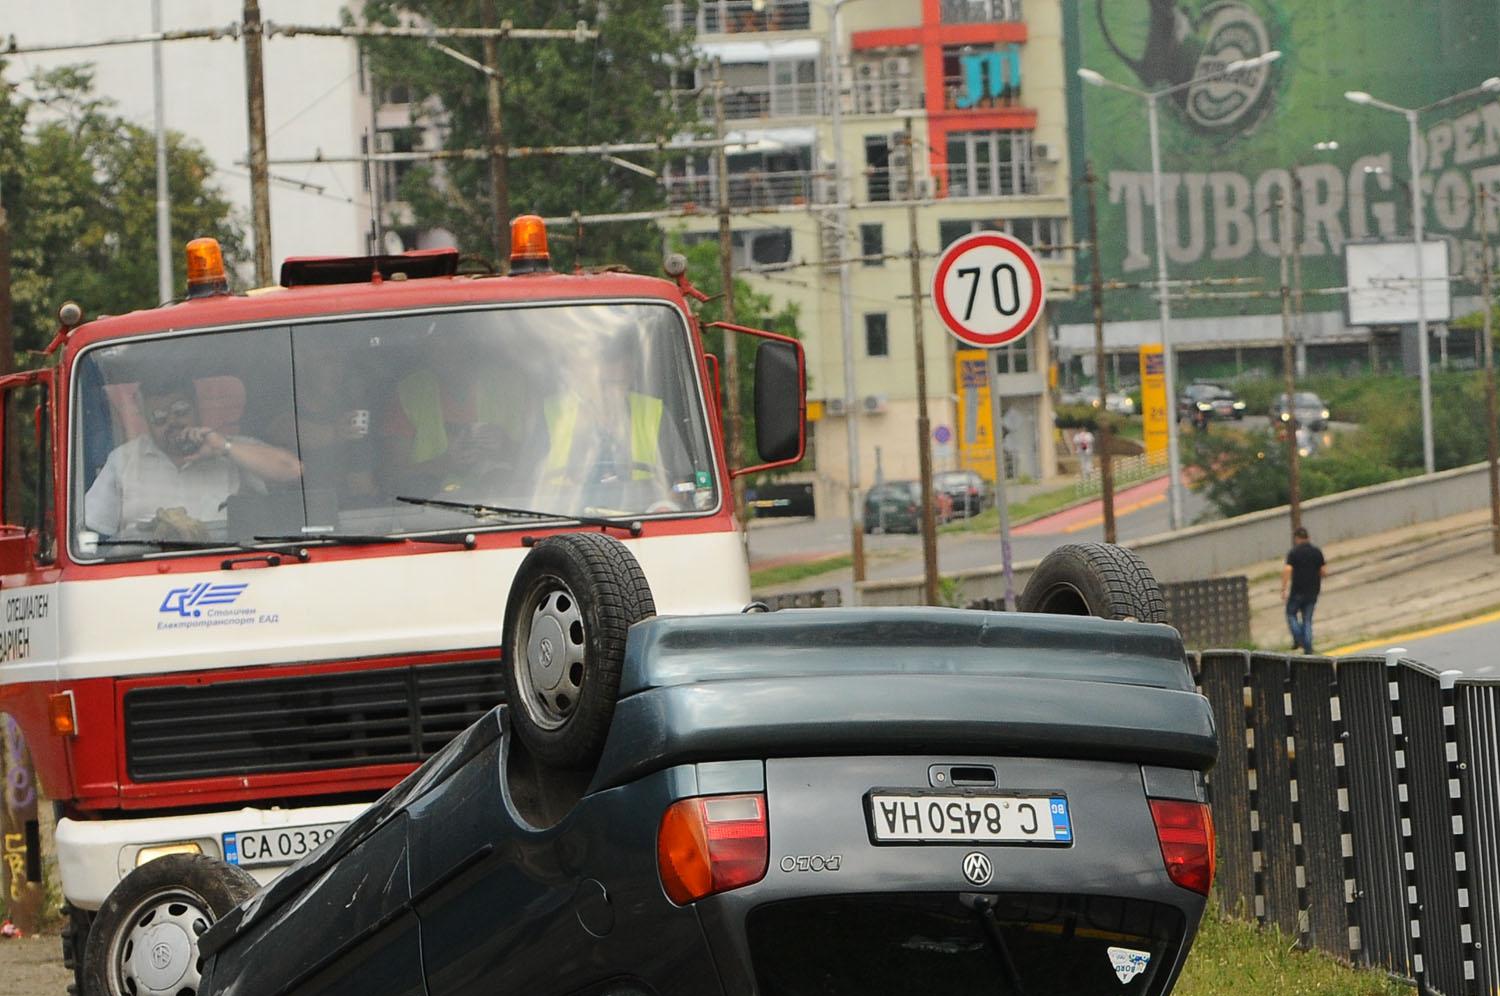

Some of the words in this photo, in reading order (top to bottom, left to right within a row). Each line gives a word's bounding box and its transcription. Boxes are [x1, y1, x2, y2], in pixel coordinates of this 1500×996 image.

[1109, 153, 1396, 273] TUBORG
[957, 263, 1020, 320] 70
[207, 608, 257, 617] Столичен
[157, 617, 255, 631] Електротранспорт
[258, 614, 279, 624] ЕАД
[1051, 804, 1065, 815] BG
[780, 855, 842, 873] POLO
